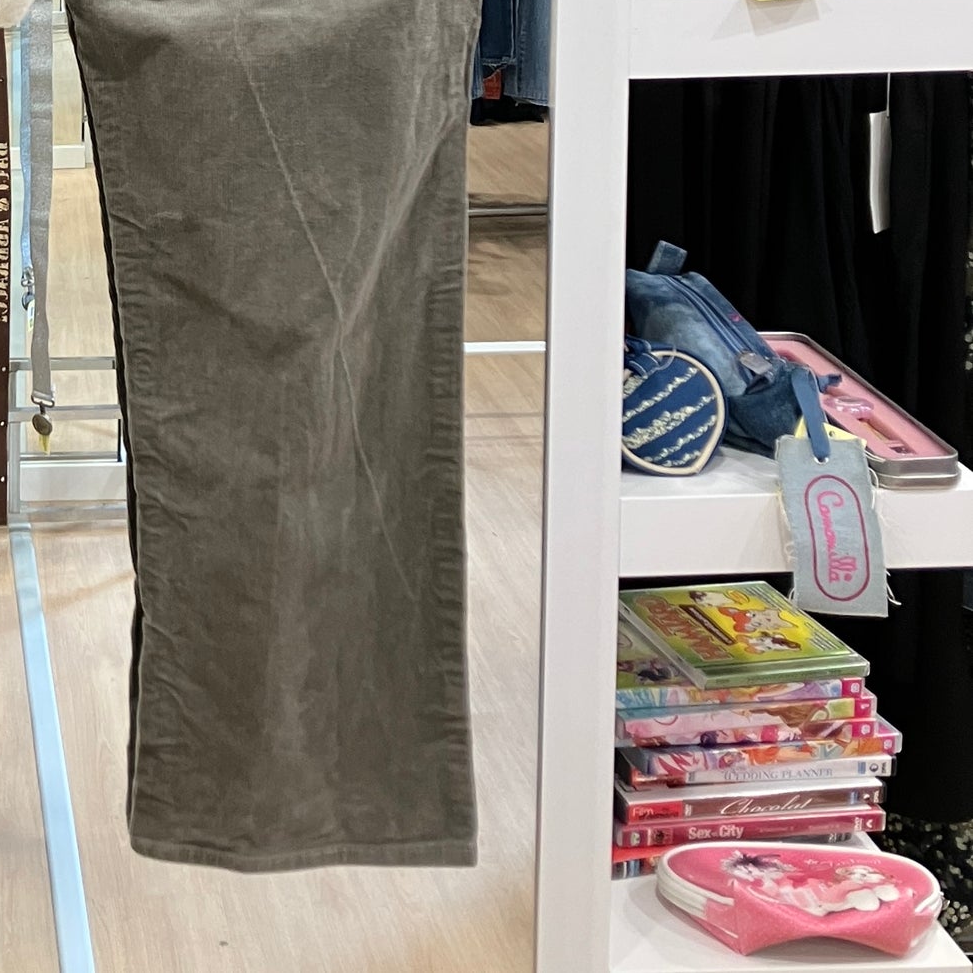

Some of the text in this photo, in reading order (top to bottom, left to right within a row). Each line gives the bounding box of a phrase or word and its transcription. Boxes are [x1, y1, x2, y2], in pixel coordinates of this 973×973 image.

[782, 768, 832, 779] PLANNER
[720, 794, 812, 814] Chocolat
[688, 826, 711, 840] Sex
[719, 824, 744, 839] City
